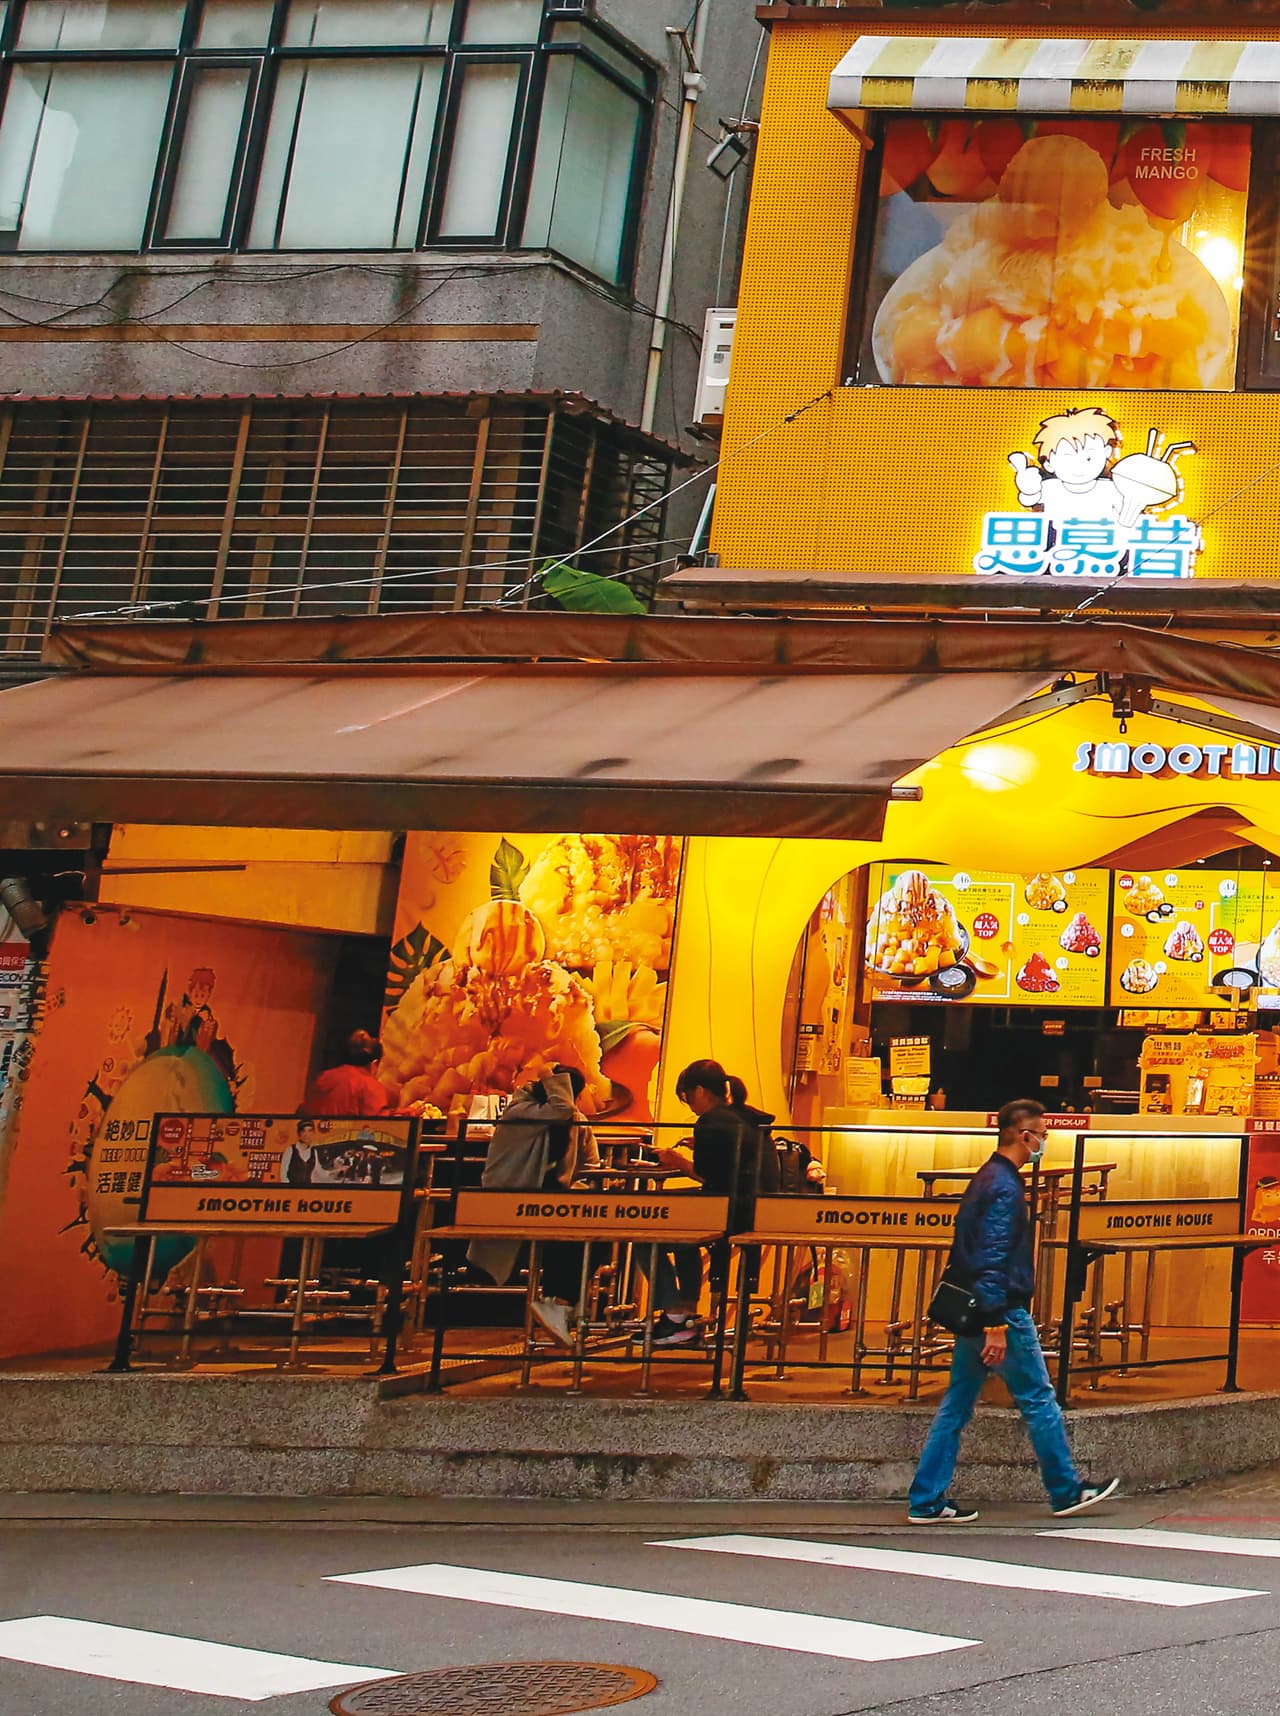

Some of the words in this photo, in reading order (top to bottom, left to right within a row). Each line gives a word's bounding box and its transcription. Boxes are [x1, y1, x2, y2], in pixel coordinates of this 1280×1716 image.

[1140, 147, 1197, 163] FRESH
[1134, 165, 1199, 181] MANGO
[977, 515, 1199, 578] 思慕昔
[978, 929, 994, 938] TOP
[1212, 945, 1229, 954] TOP
[1054, 1118, 1087, 1127] PICK-UP
[197, 1197, 291, 1213] SMOOTHIE
[297, 1198, 353, 1214] HOUSE
[515, 1202, 609, 1220] SMOOTHIE
[614, 1203, 671, 1220] HOUSE
[815, 1208, 908, 1226] SMOOTHIE
[914, 1210, 958, 1228] HOUS
[1106, 1214, 1172, 1230] SMOOTHIE
[1175, 1212, 1214, 1228] HOUSE
